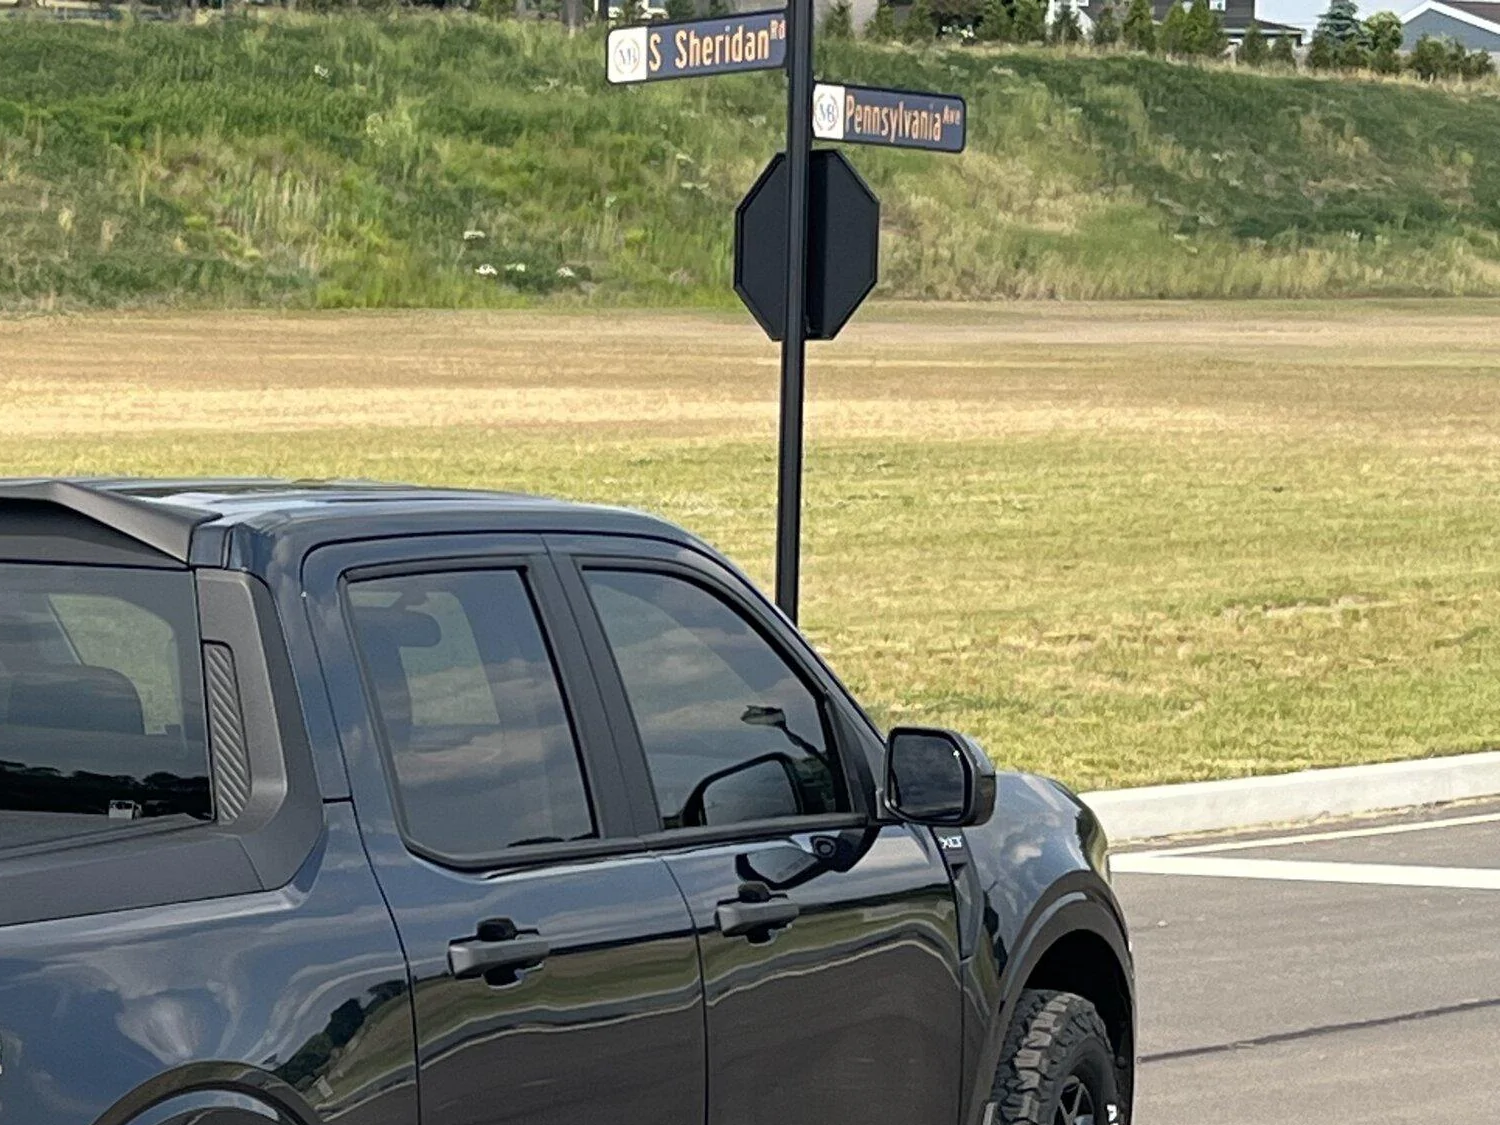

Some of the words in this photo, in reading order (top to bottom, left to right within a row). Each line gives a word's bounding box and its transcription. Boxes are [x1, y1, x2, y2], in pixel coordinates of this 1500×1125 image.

[649, 32, 662, 72] S
[675, 24, 770, 70] Sheridan
[845, 94, 942, 143] Pennsylvania
[943, 104, 961, 125] Ave
